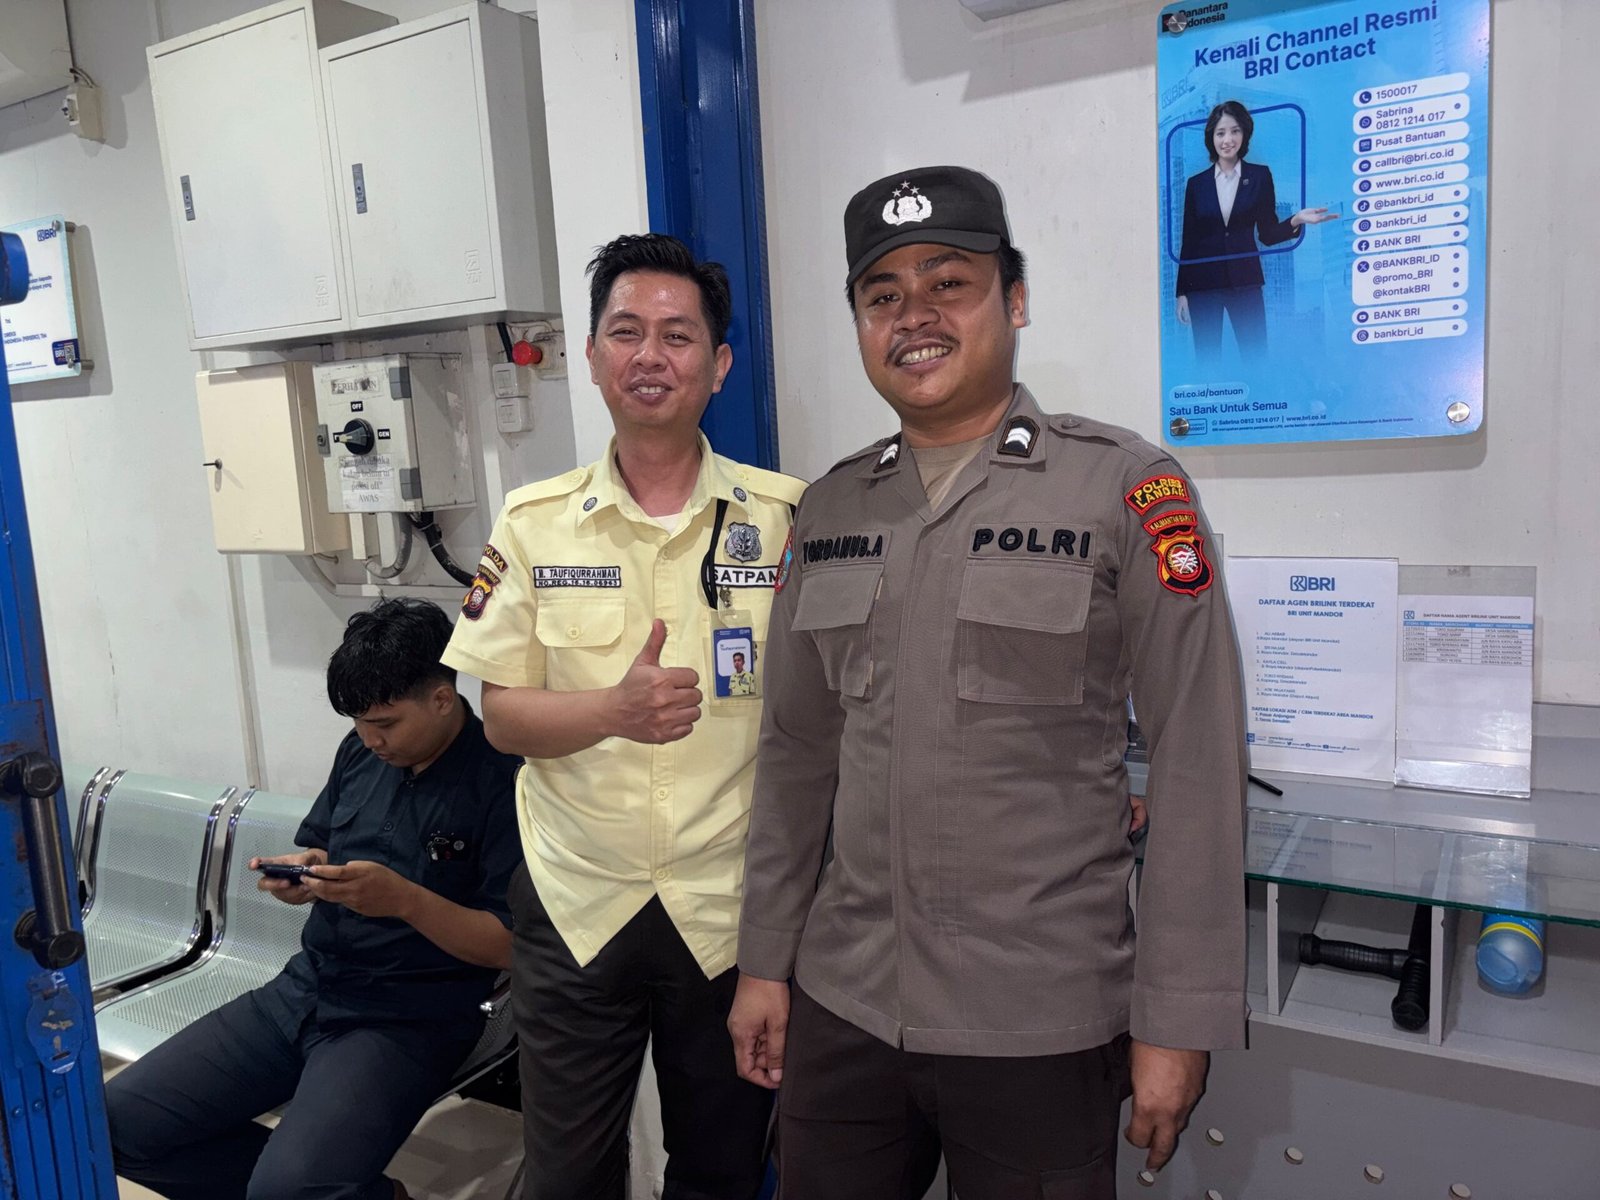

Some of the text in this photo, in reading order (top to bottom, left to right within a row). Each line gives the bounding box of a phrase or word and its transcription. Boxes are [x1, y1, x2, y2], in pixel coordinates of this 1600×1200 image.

[1195, 0, 1437, 67] Kenali Channel Resmi
[1245, 38, 1376, 79] BRI Contact
[1376, 85, 1417, 100] 1500017
[1376, 106, 1413, 119] Sabrina
[1376, 111, 1446, 130] 0812 1214 017
[1375, 130, 1446, 148] Pusat Bantuan
[1375, 148, 1454, 168] callbri@bri.co.id
[1376, 171, 1445, 189] www.bri.co.id
[1374, 193, 1434, 210] @bankbri_id
[1376, 214, 1427, 229] bankbri_id
[1374, 235, 1421, 248] BANK BRI
[1373, 254, 1440, 271] @BANKBRI_ID
[1373, 269, 1433, 285] @promo_BRI
[1373, 284, 1430, 299] @kontakBRI
[1374, 307, 1420, 320] BANK BRI
[1374, 327, 1423, 339] bankbri_id
[1174, 388, 1244, 399] bri.co.id/bantuan
[1169, 402, 1288, 416] Satu Bank Untuk Semua
[1134, 478, 1183, 500] POLRES
[359, 494, 379, 503] AWAS
[1136, 487, 1185, 508] LANDAK
[972, 527, 1091, 559] POLRI
[550, 569, 617, 578] TAUFIQURRAHMAN
[1308, 577, 1336, 591] BRI
